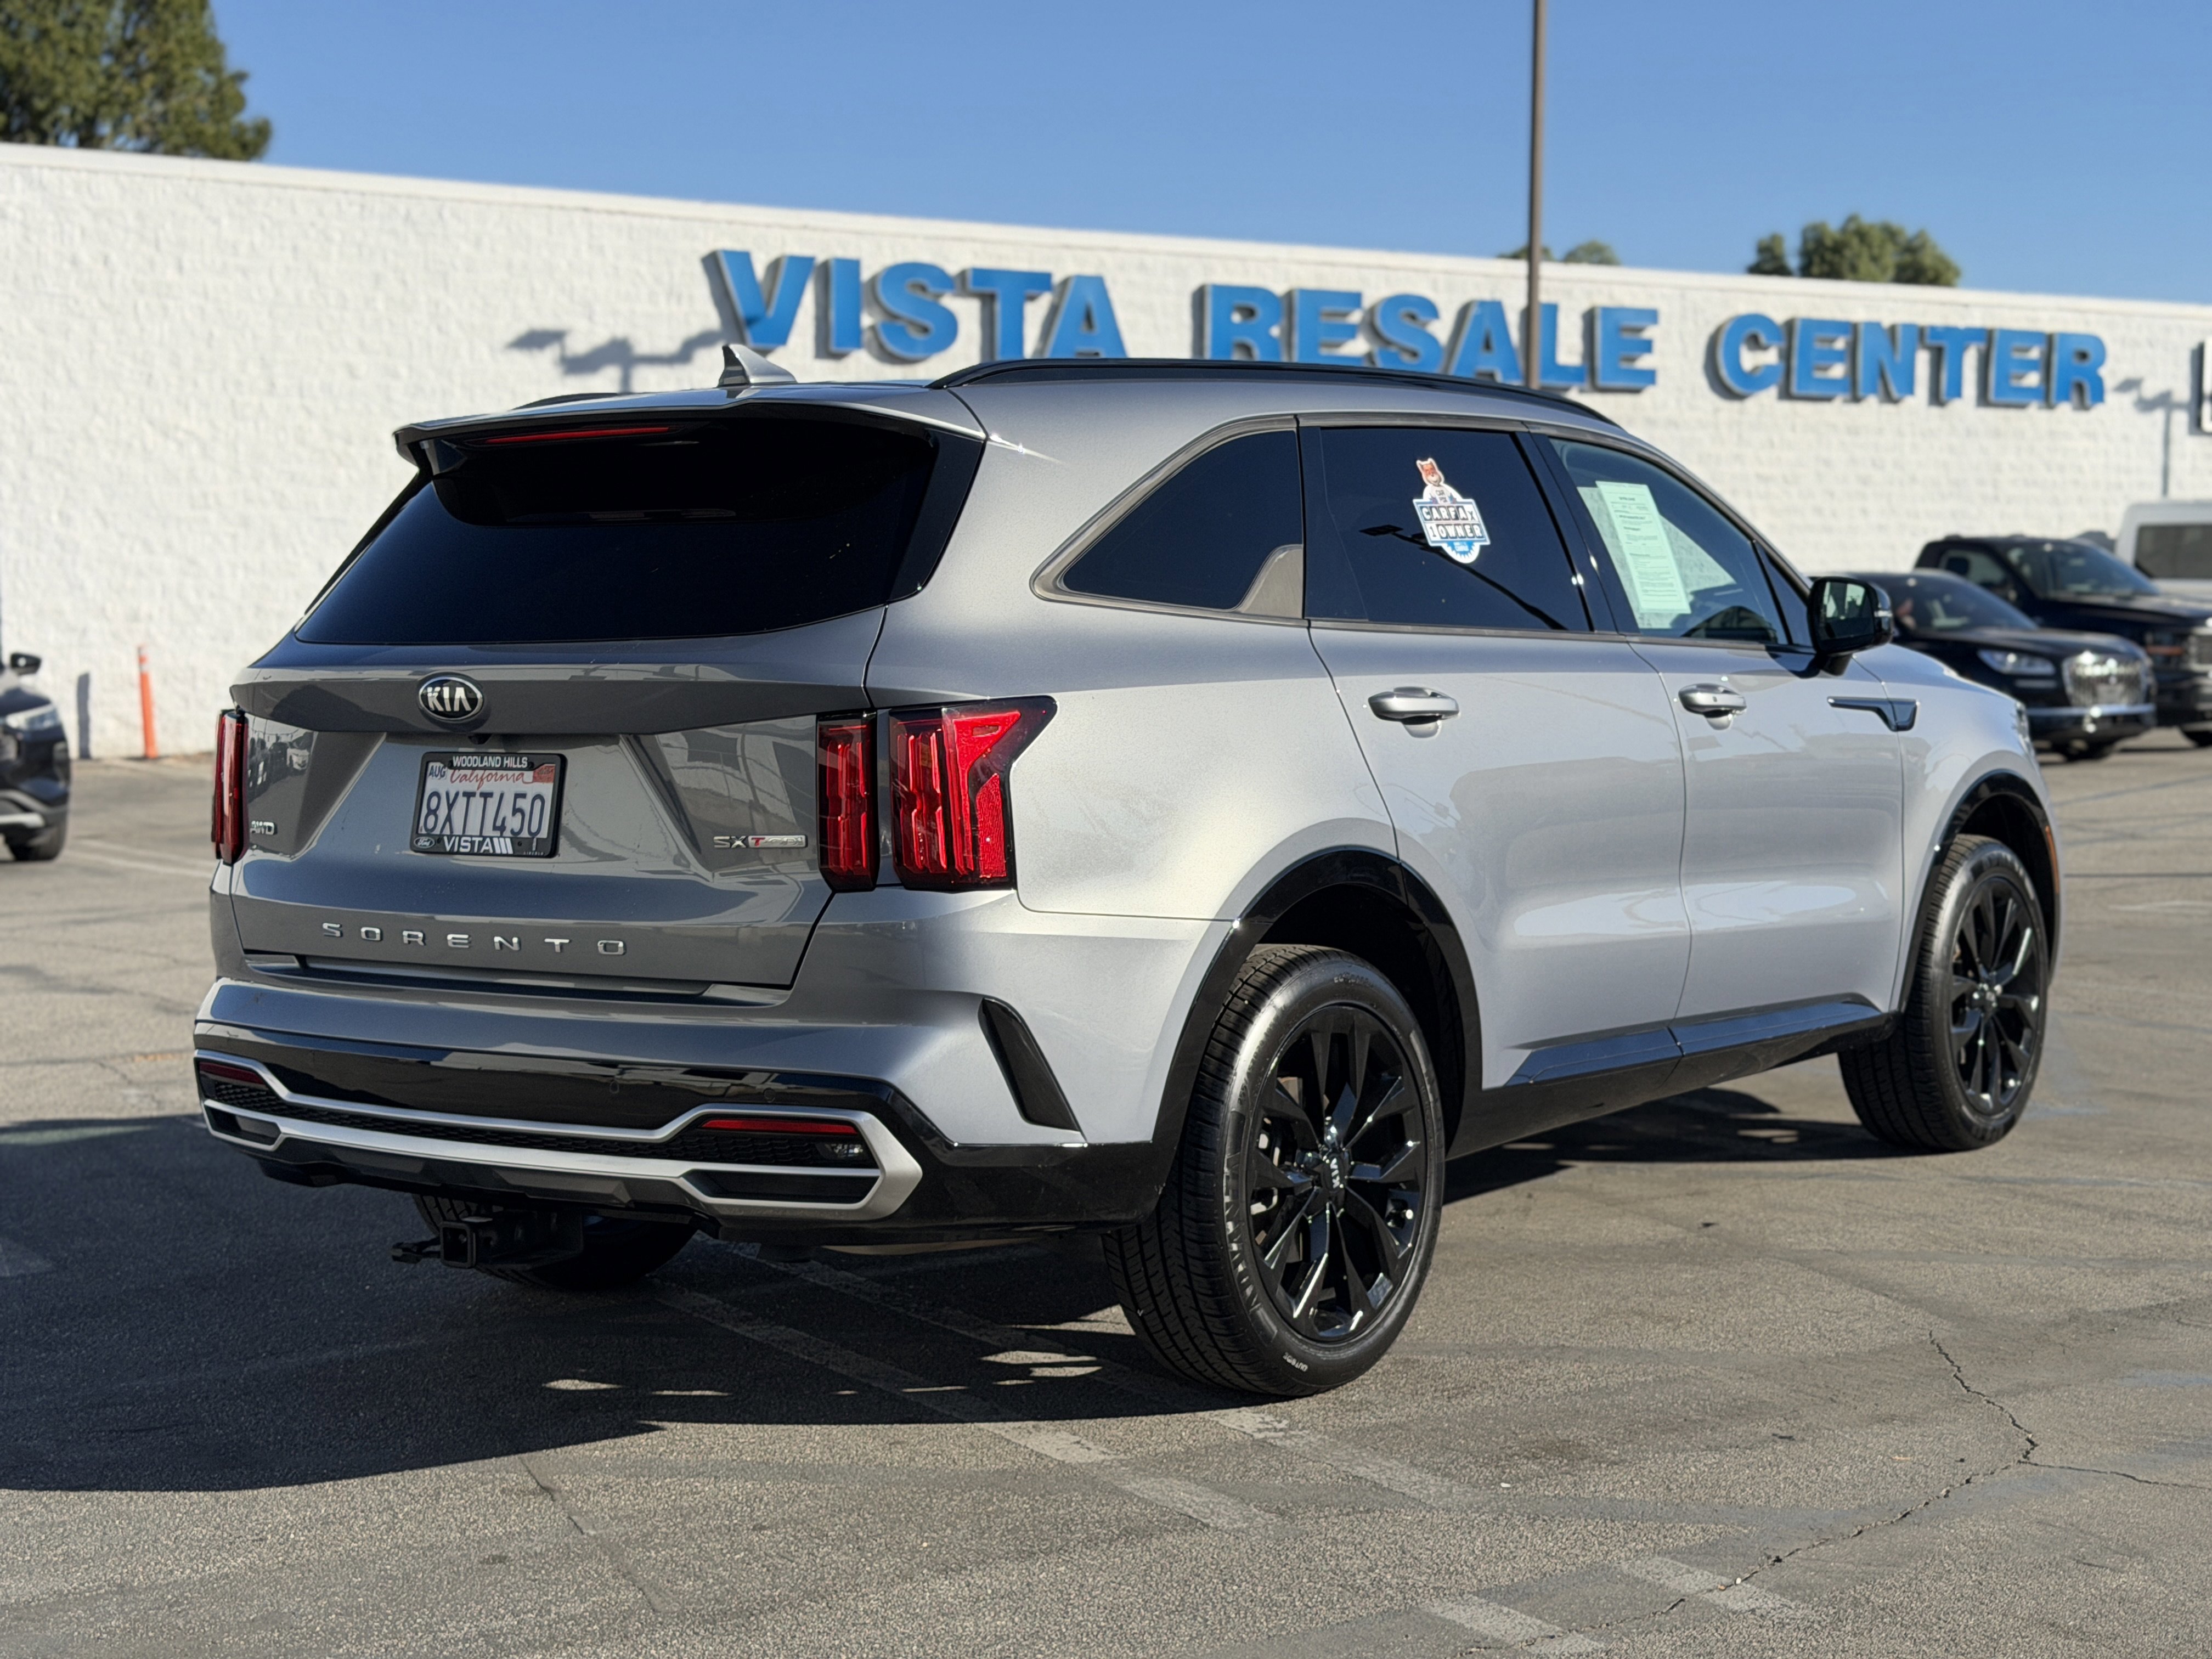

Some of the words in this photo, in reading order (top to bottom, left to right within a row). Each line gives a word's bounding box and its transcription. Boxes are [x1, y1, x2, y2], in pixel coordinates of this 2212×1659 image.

[713, 249, 1129, 361] VISTA
[1201, 284, 1659, 388] RESALE
[1714, 313, 2108, 407] CENTER
[1420, 505, 1477, 521] CARFAX
[1437, 524, 1484, 539] OWNER
[426, 686, 472, 712] KIA
[428, 764, 447, 778] AUG
[452, 755, 501, 768] WOODLAND
[503, 756, 528, 769] HILLS
[450, 769, 535, 791] California
[422, 790, 546, 838] 8XTT450
[443, 837, 494, 853] VISTA
[322, 922, 627, 956] SORENTO
